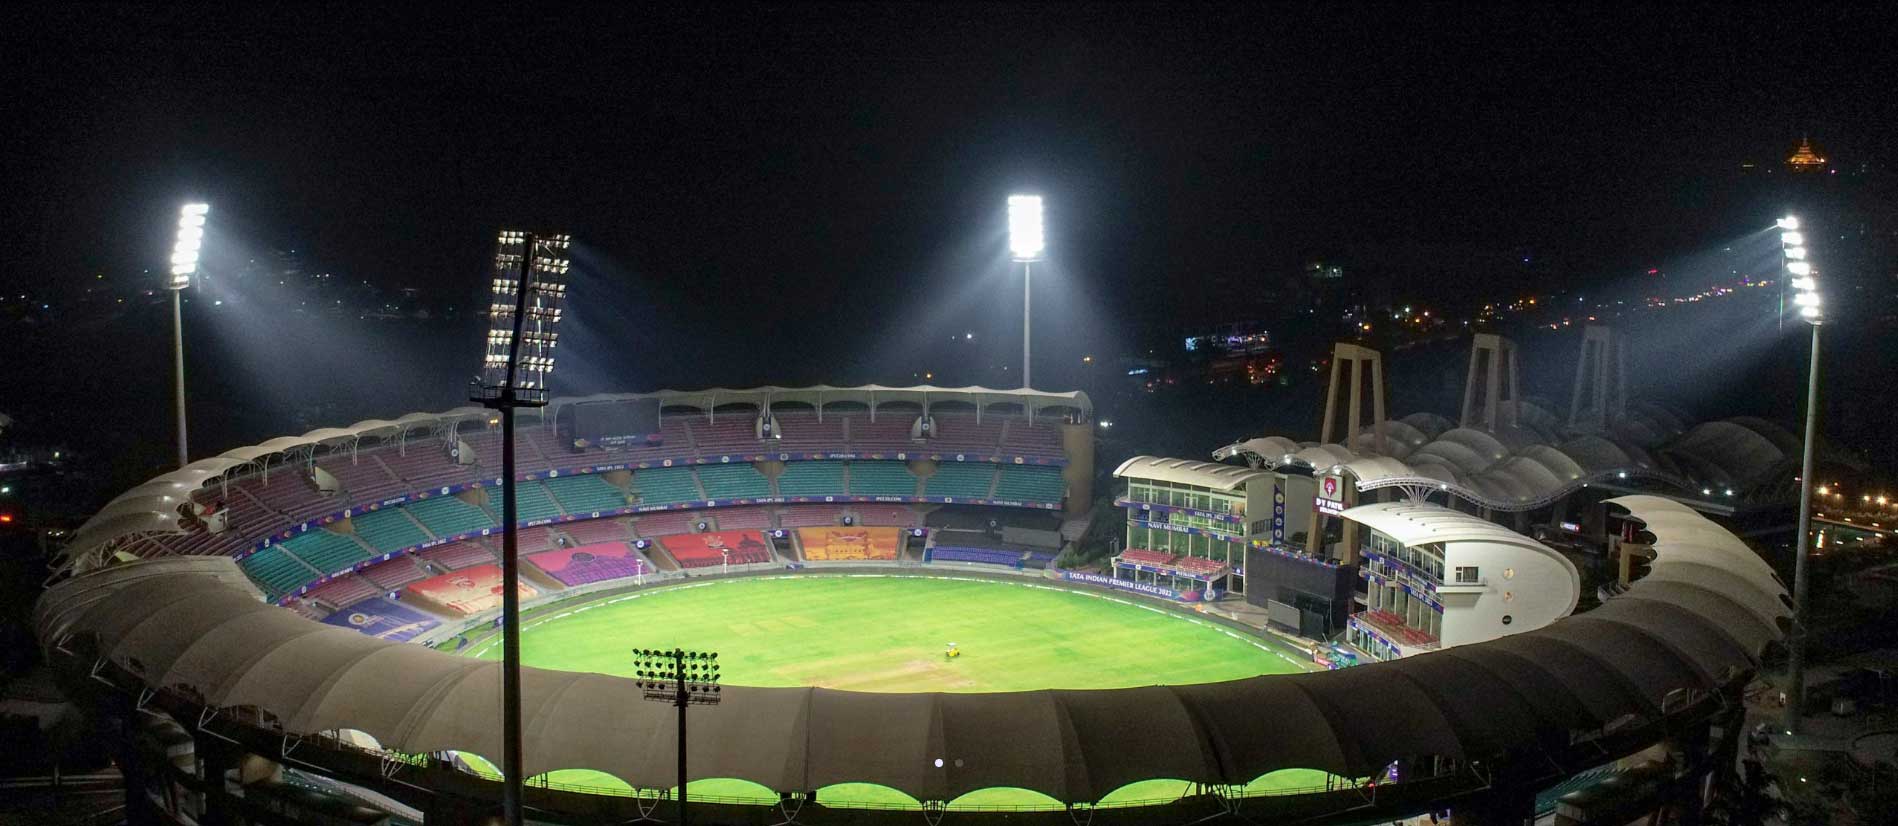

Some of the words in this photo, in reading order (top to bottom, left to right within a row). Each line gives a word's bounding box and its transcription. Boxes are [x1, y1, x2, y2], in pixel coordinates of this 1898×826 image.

[1316, 498, 1326, 507] DY
[1069, 572, 1084, 580] TATA
[1085, 574, 1108, 584] INDIAN
[1109, 578, 1134, 588] PREMIER
[1135, 583, 1157, 594] LEAGUE
[1159, 588, 1172, 597] 2022
